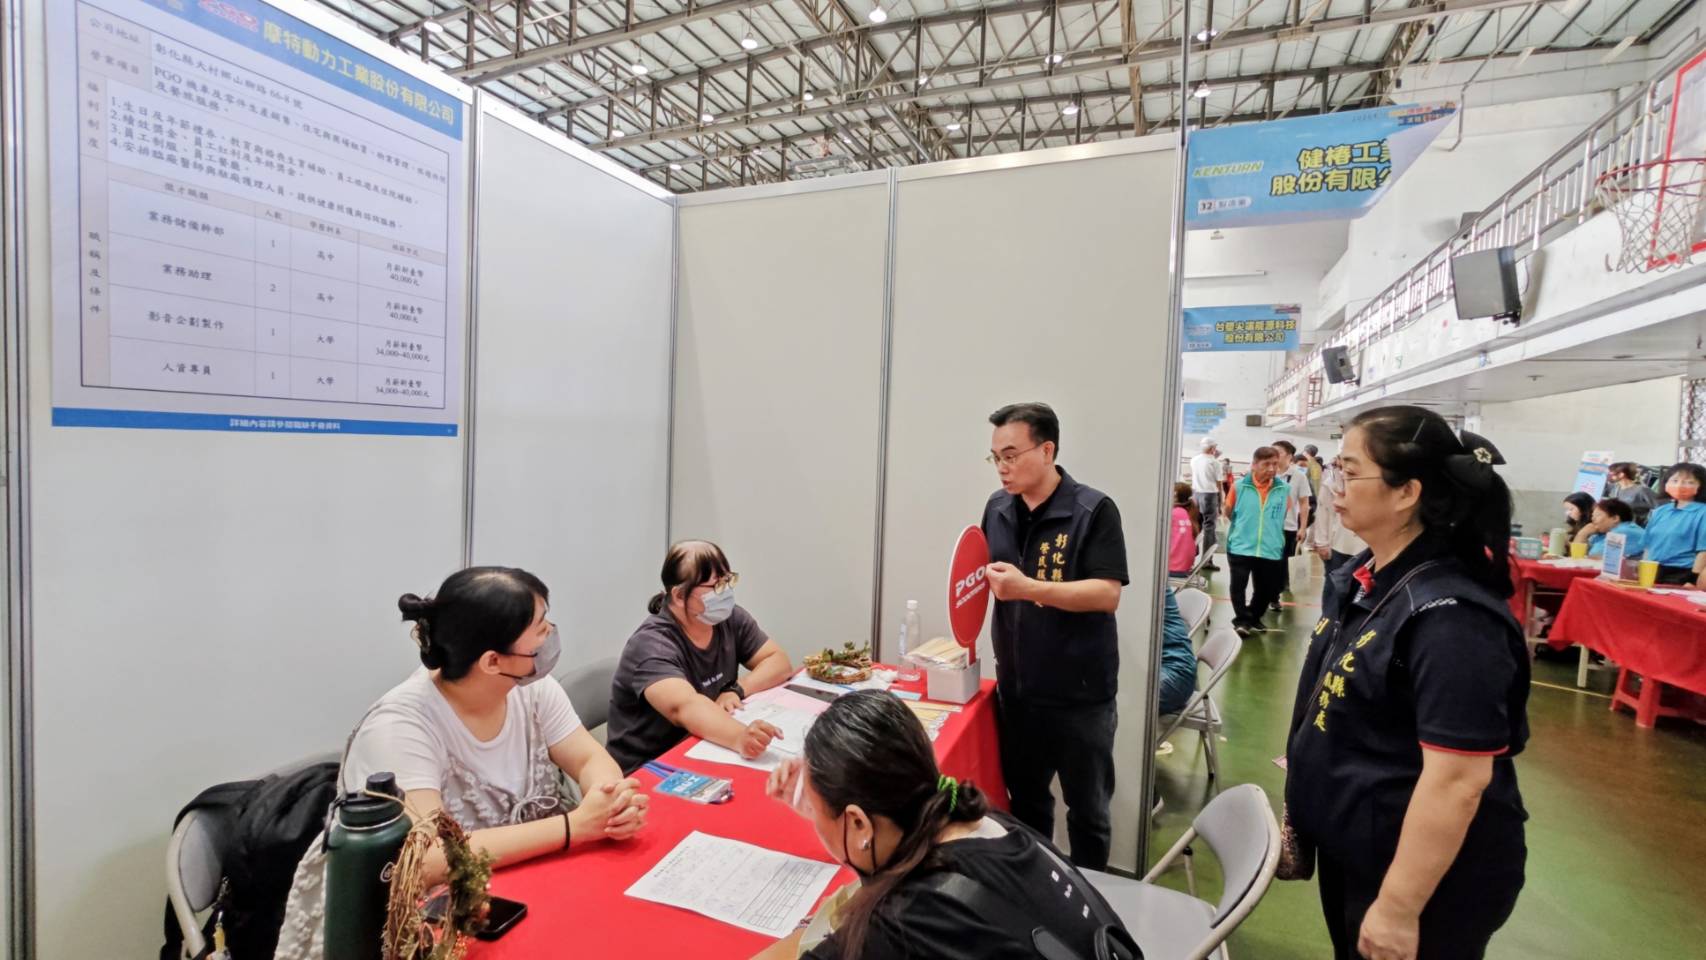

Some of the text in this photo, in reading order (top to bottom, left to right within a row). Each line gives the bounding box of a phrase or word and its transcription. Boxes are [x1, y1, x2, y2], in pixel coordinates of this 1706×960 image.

[154, 65, 182, 84] PGO
[263, 20, 456, 126] 摩特動力工業股份有限公司
[1192, 160, 1264, 178] KENTURN
[148, 211, 225, 235] 業務儲備幹部
[316, 251, 334, 261] 高中
[162, 264, 213, 281] 業務助理
[316, 292, 334, 302] 高中
[148, 311, 224, 331] 影音企劃製作
[316, 336, 334, 345] 大學
[162, 362, 212, 375] 人資專員
[316, 377, 334, 386] 大學
[1051, 533, 1069, 583] 彰化縣
[955, 565, 986, 598] PGO
